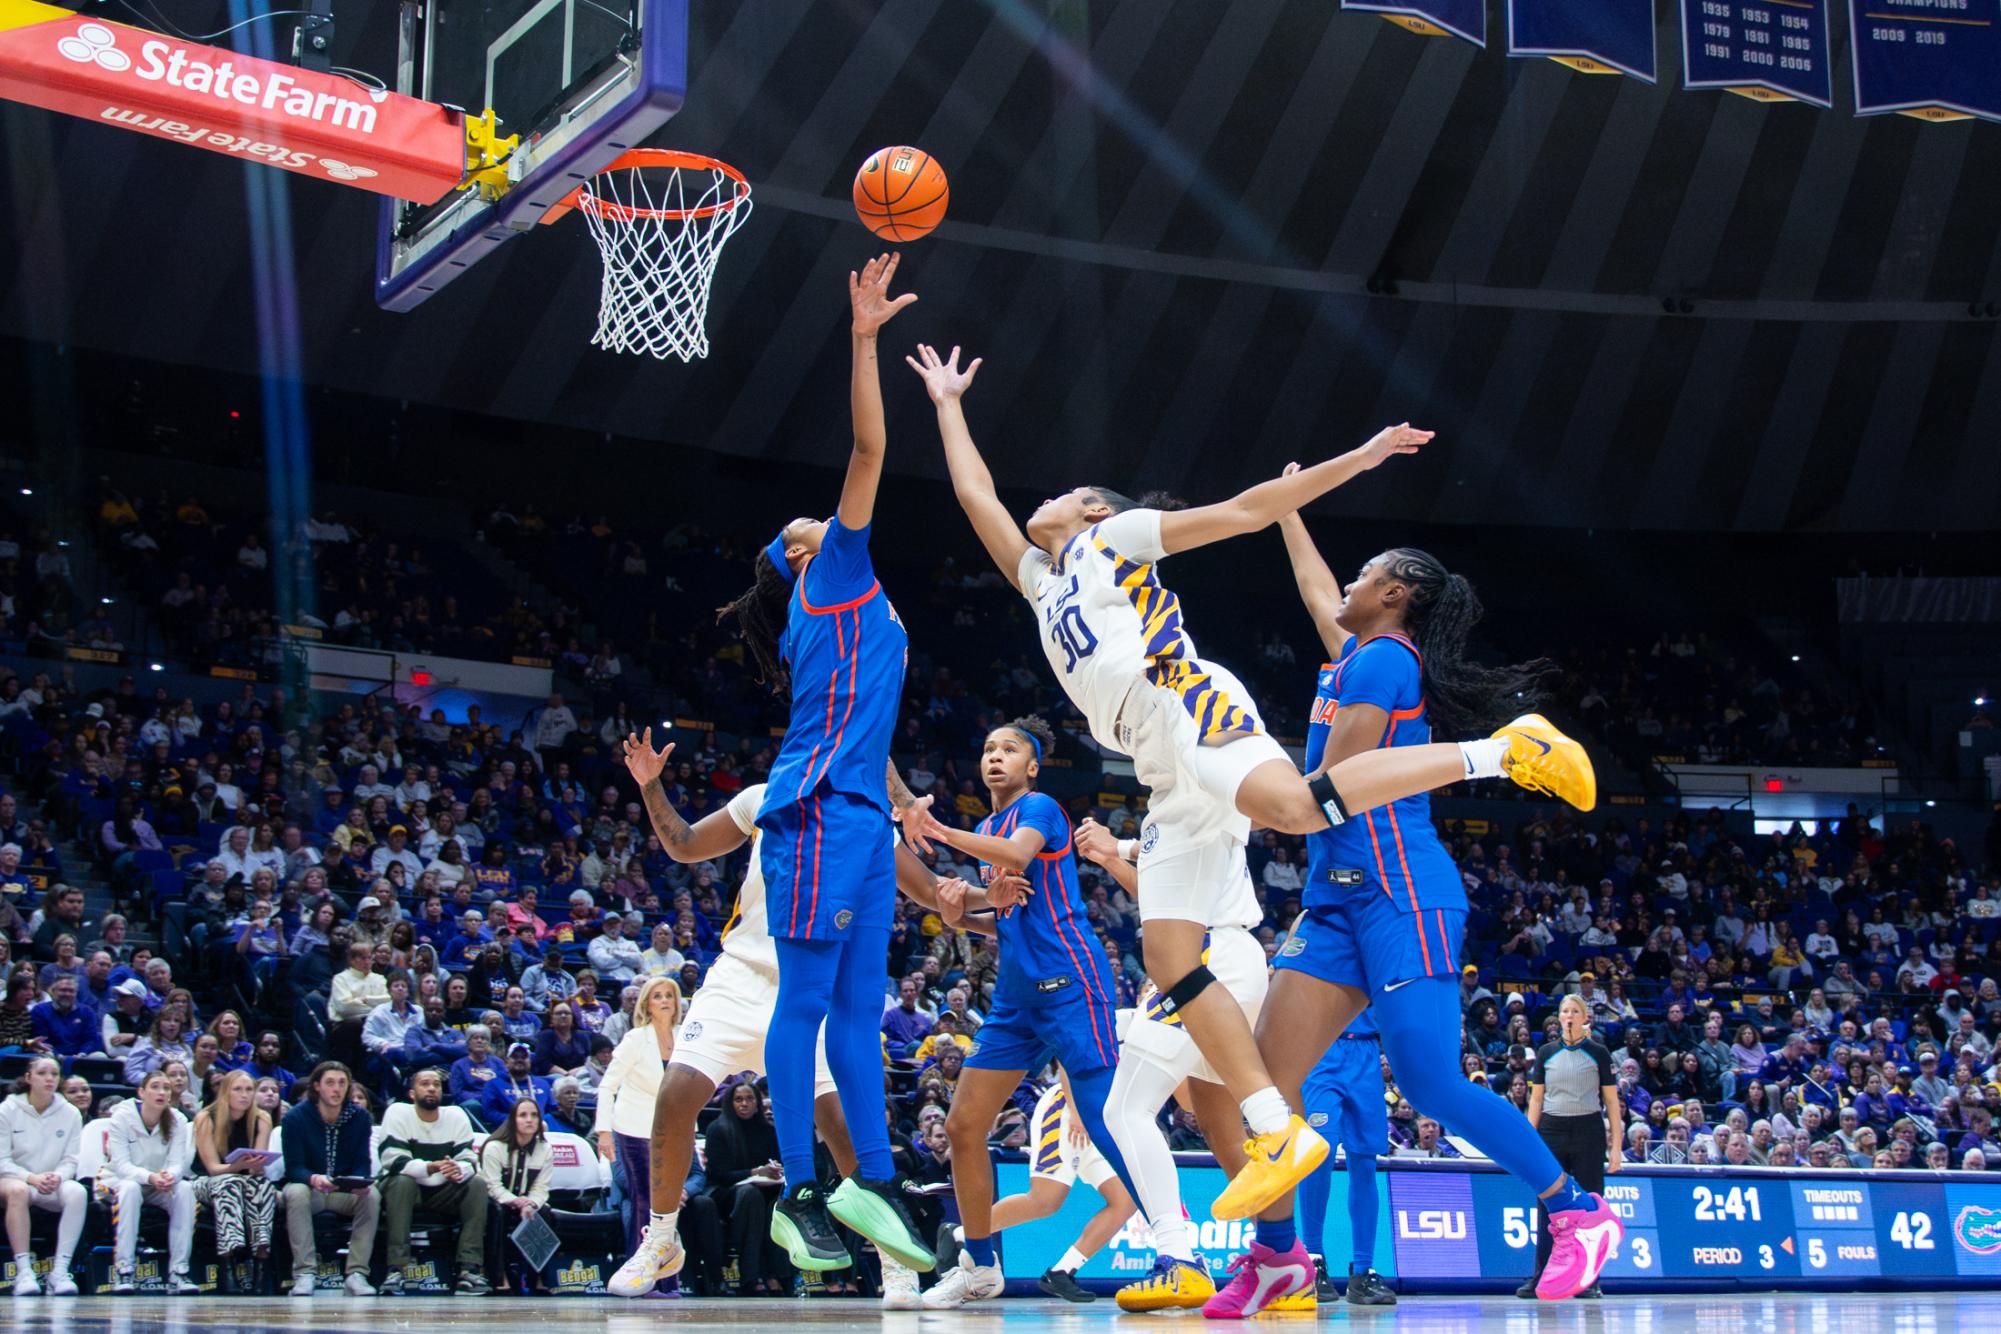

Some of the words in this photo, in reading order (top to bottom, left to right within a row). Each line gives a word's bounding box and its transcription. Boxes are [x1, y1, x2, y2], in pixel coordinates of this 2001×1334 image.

[1702, 1, 1731, 18] 1935
[1741, 7, 1771, 24] 1953
[1781, 13, 1810, 30] 1954
[1703, 22, 1731, 39] 1979
[1743, 28, 1771, 45] 1981
[1782, 34, 1811, 51] 1985
[1872, 27, 1906, 43] 2009
[1915, 30, 1947, 46] 2019
[1704, 43, 1731, 60] 1991
[1742, 49, 1775, 67] 2000
[1780, 55, 1812, 72] 2006
[1046, 573, 1079, 625] LSU
[1051, 604, 1099, 674] 30
[1604, 1186, 1640, 1200] OUTS
[1692, 1186, 1761, 1222] 2:41
[1803, 1189, 1863, 1204] TIMEOUTS
[1398, 1210, 1467, 1240] LSU
[1890, 1211, 1934, 1250] 42
[1111, 1251, 1223, 1271] Ambce
[1631, 1237, 1652, 1269] 3
[1693, 1247, 1743, 1265] PERIOD
[1758, 1244, 1775, 1270] 3
[1808, 1238, 1827, 1269] 5
[1837, 1245, 1877, 1261] FOULS
[558, 1265, 598, 1285] Bengal
